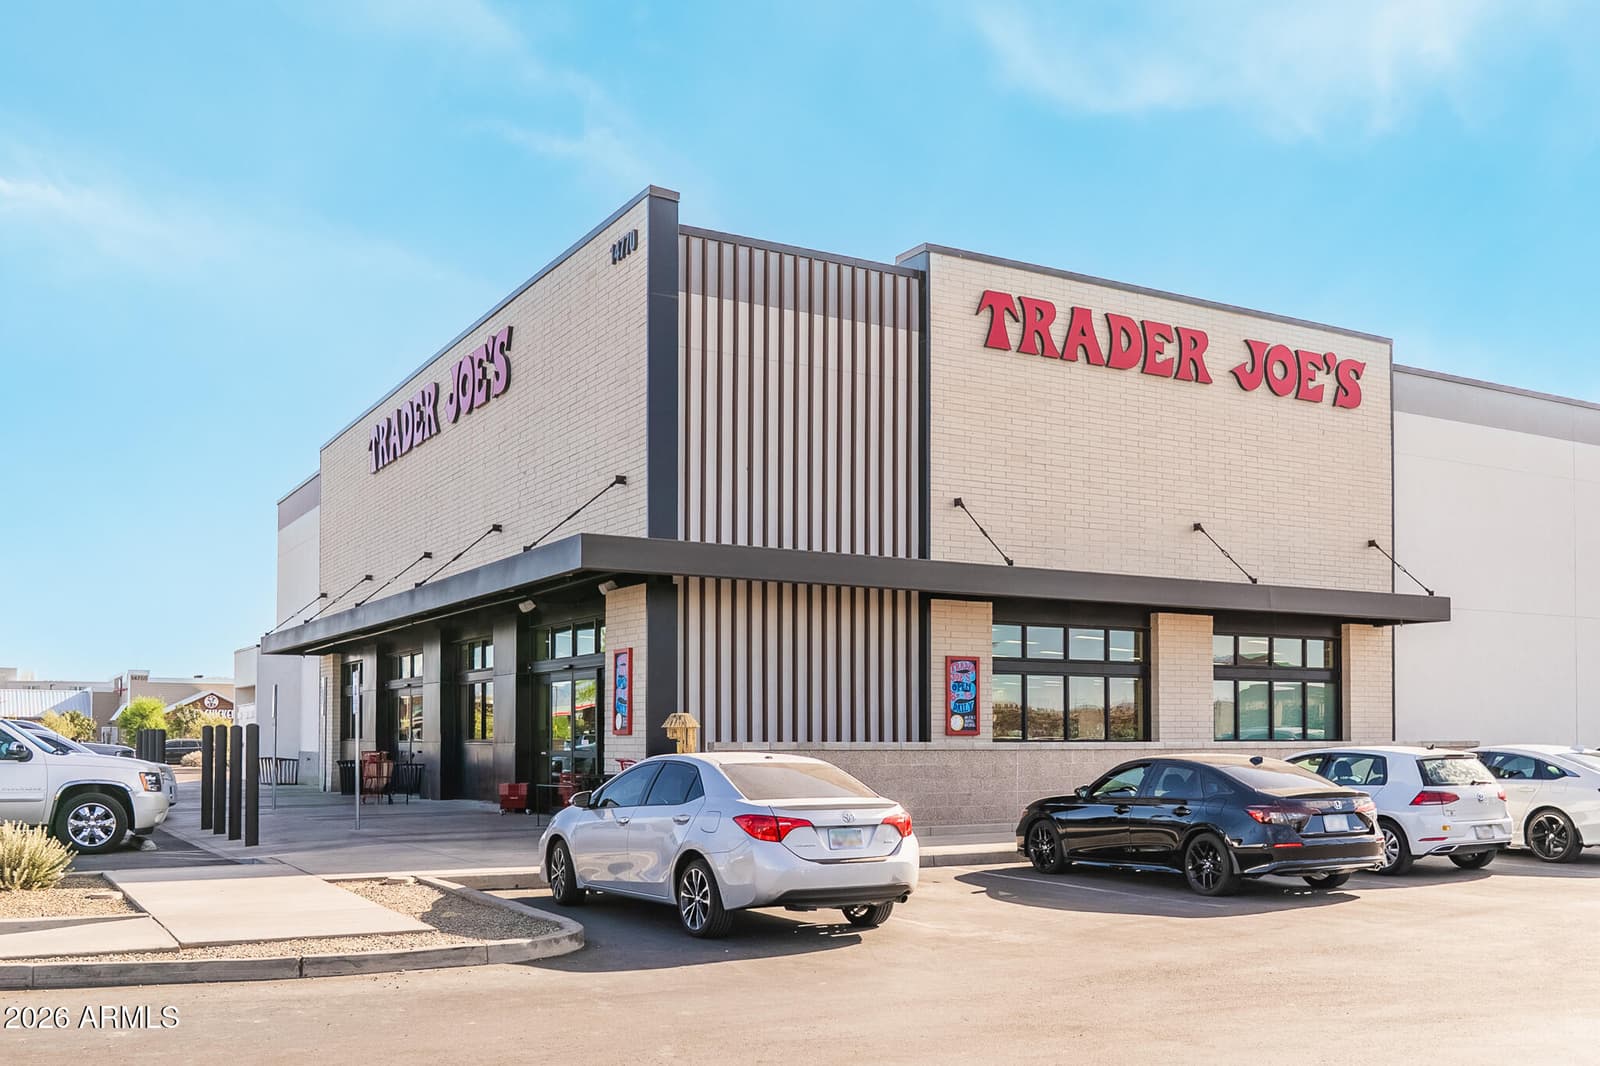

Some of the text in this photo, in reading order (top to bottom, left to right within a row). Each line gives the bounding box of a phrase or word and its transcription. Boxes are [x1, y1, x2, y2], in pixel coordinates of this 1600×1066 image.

[369, 325, 513, 474] TRADER JOE'S
[976, 290, 1366, 409] TRADER JOE'S
[953, 701, 974, 712] DAILY
